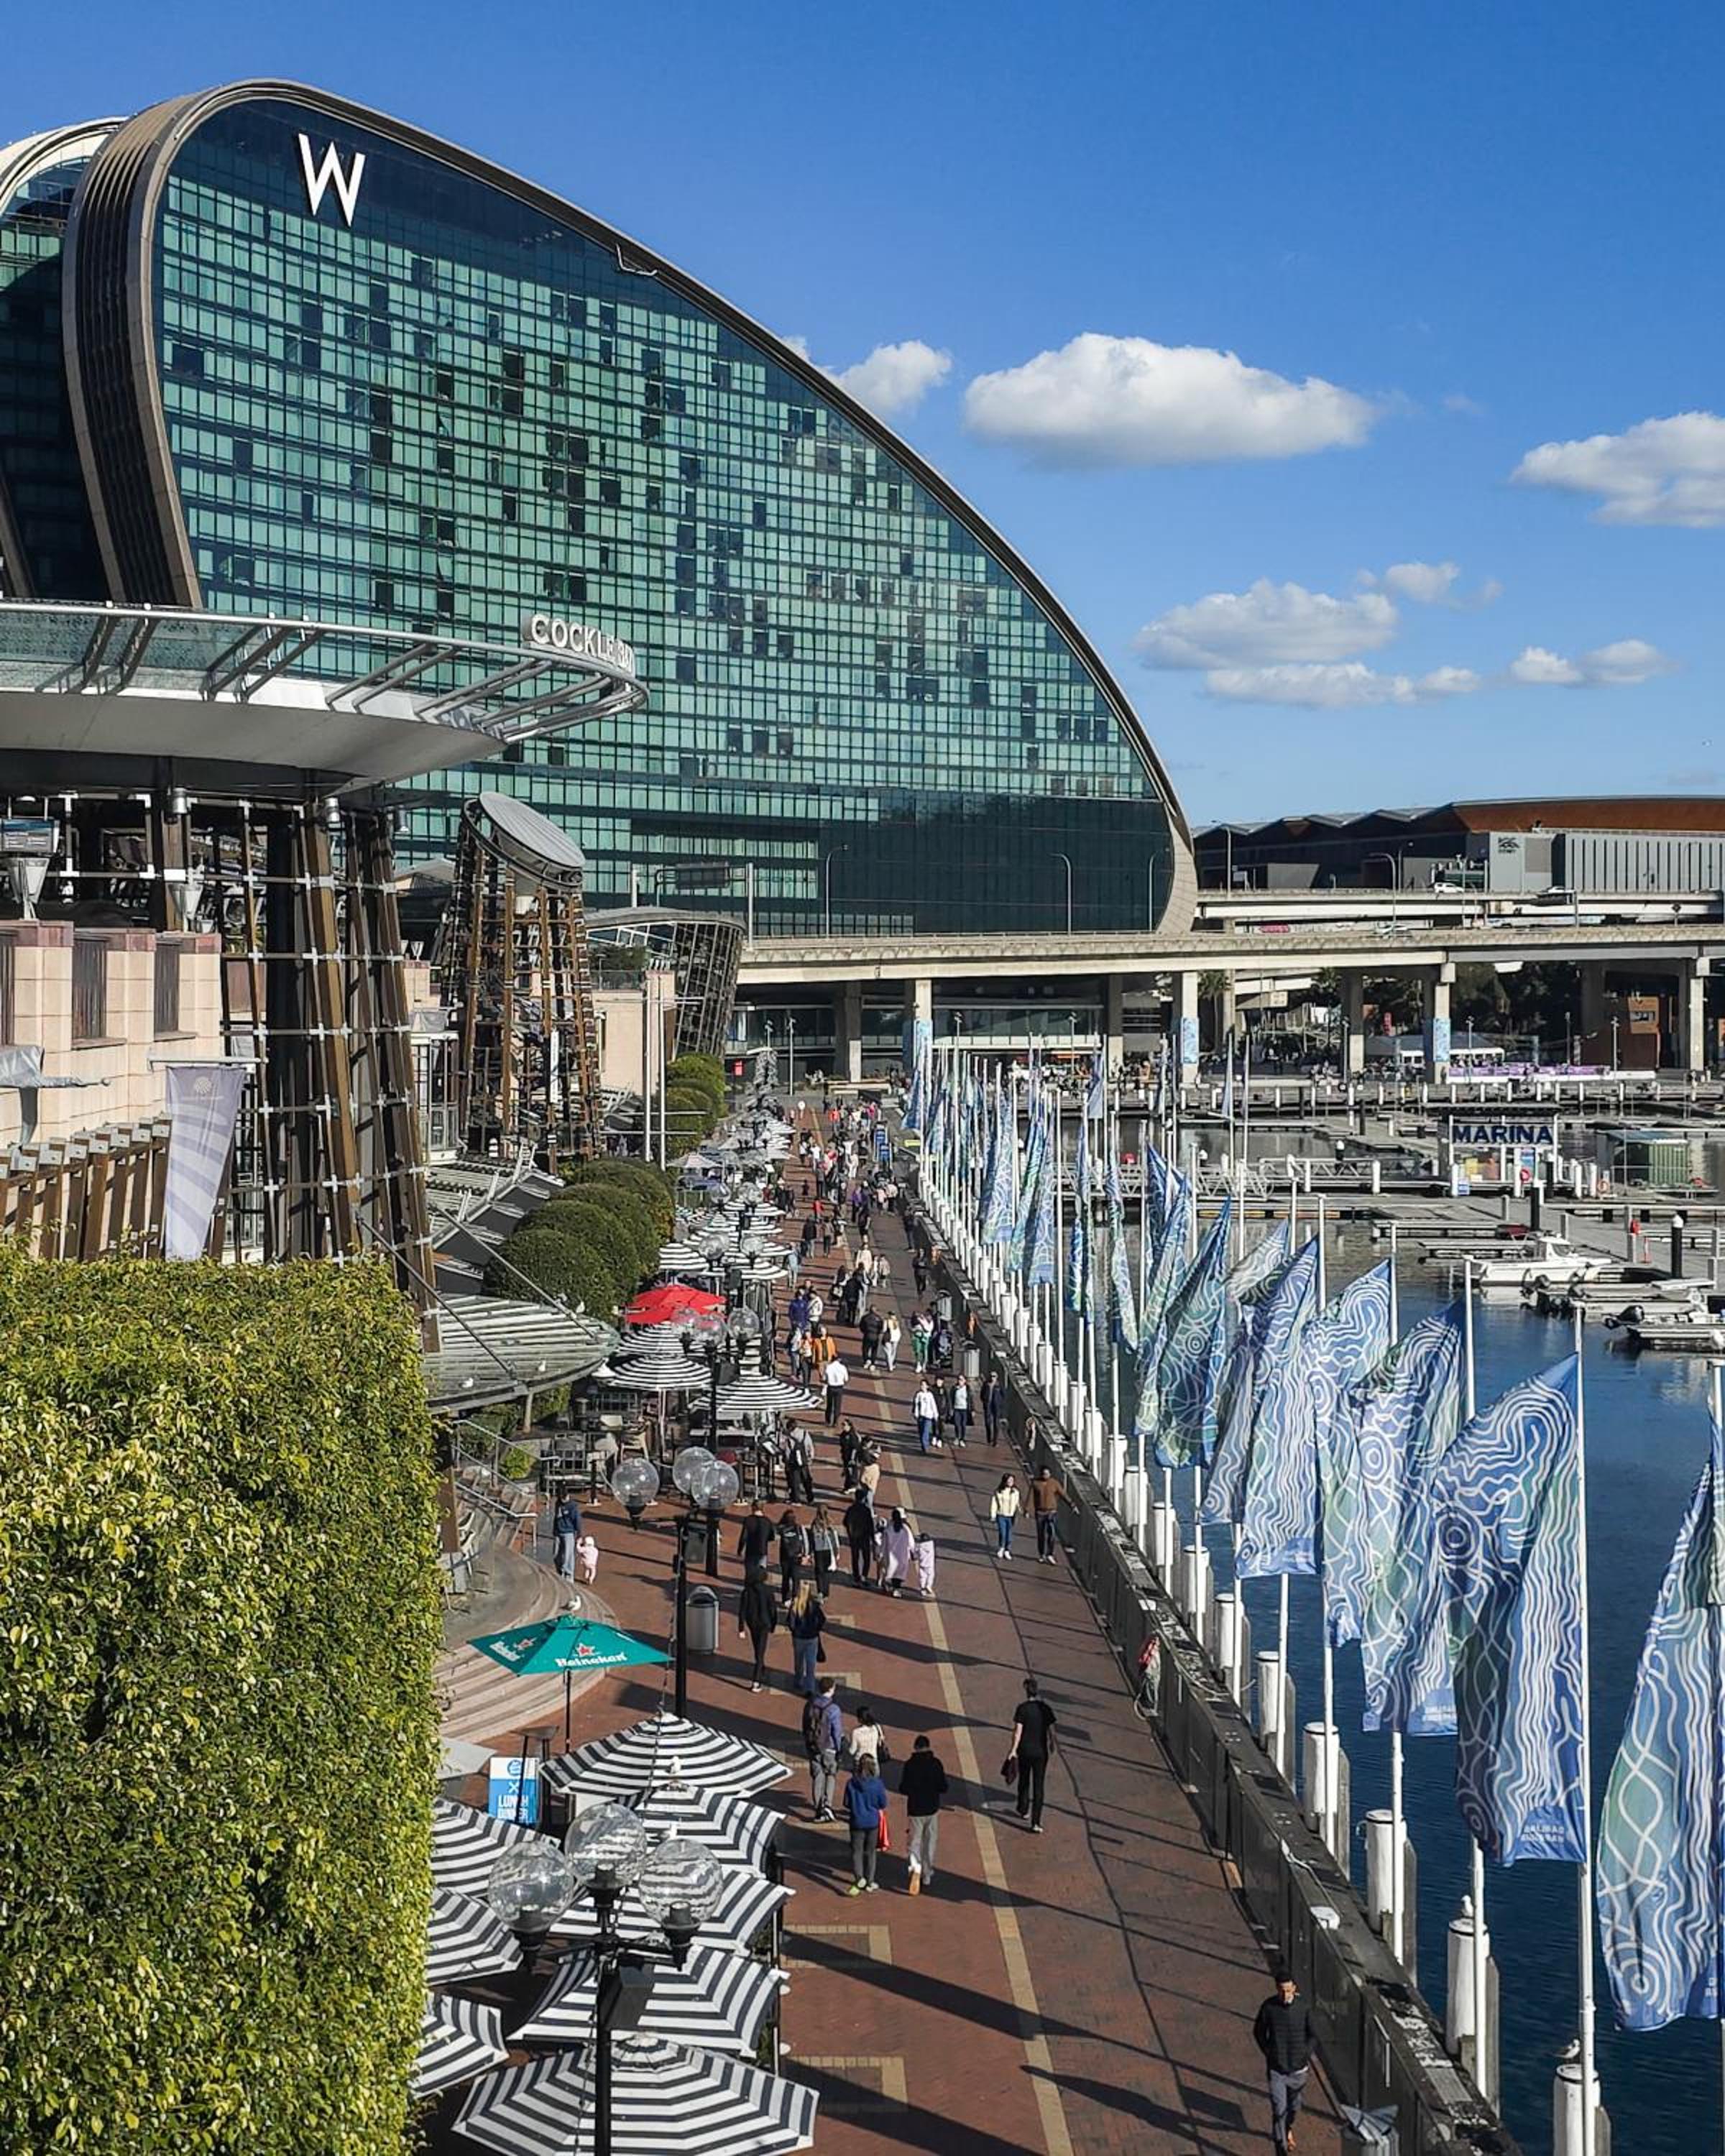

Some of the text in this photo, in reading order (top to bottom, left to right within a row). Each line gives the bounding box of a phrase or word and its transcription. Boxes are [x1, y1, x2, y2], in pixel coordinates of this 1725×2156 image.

[298, 133, 366, 227] W
[531, 613, 615, 665] COCKLE
[1452, 1125, 1553, 1144] MARINA
[554, 1651, 627, 1667] Heineken
[498, 1794, 529, 1807] LUNH
